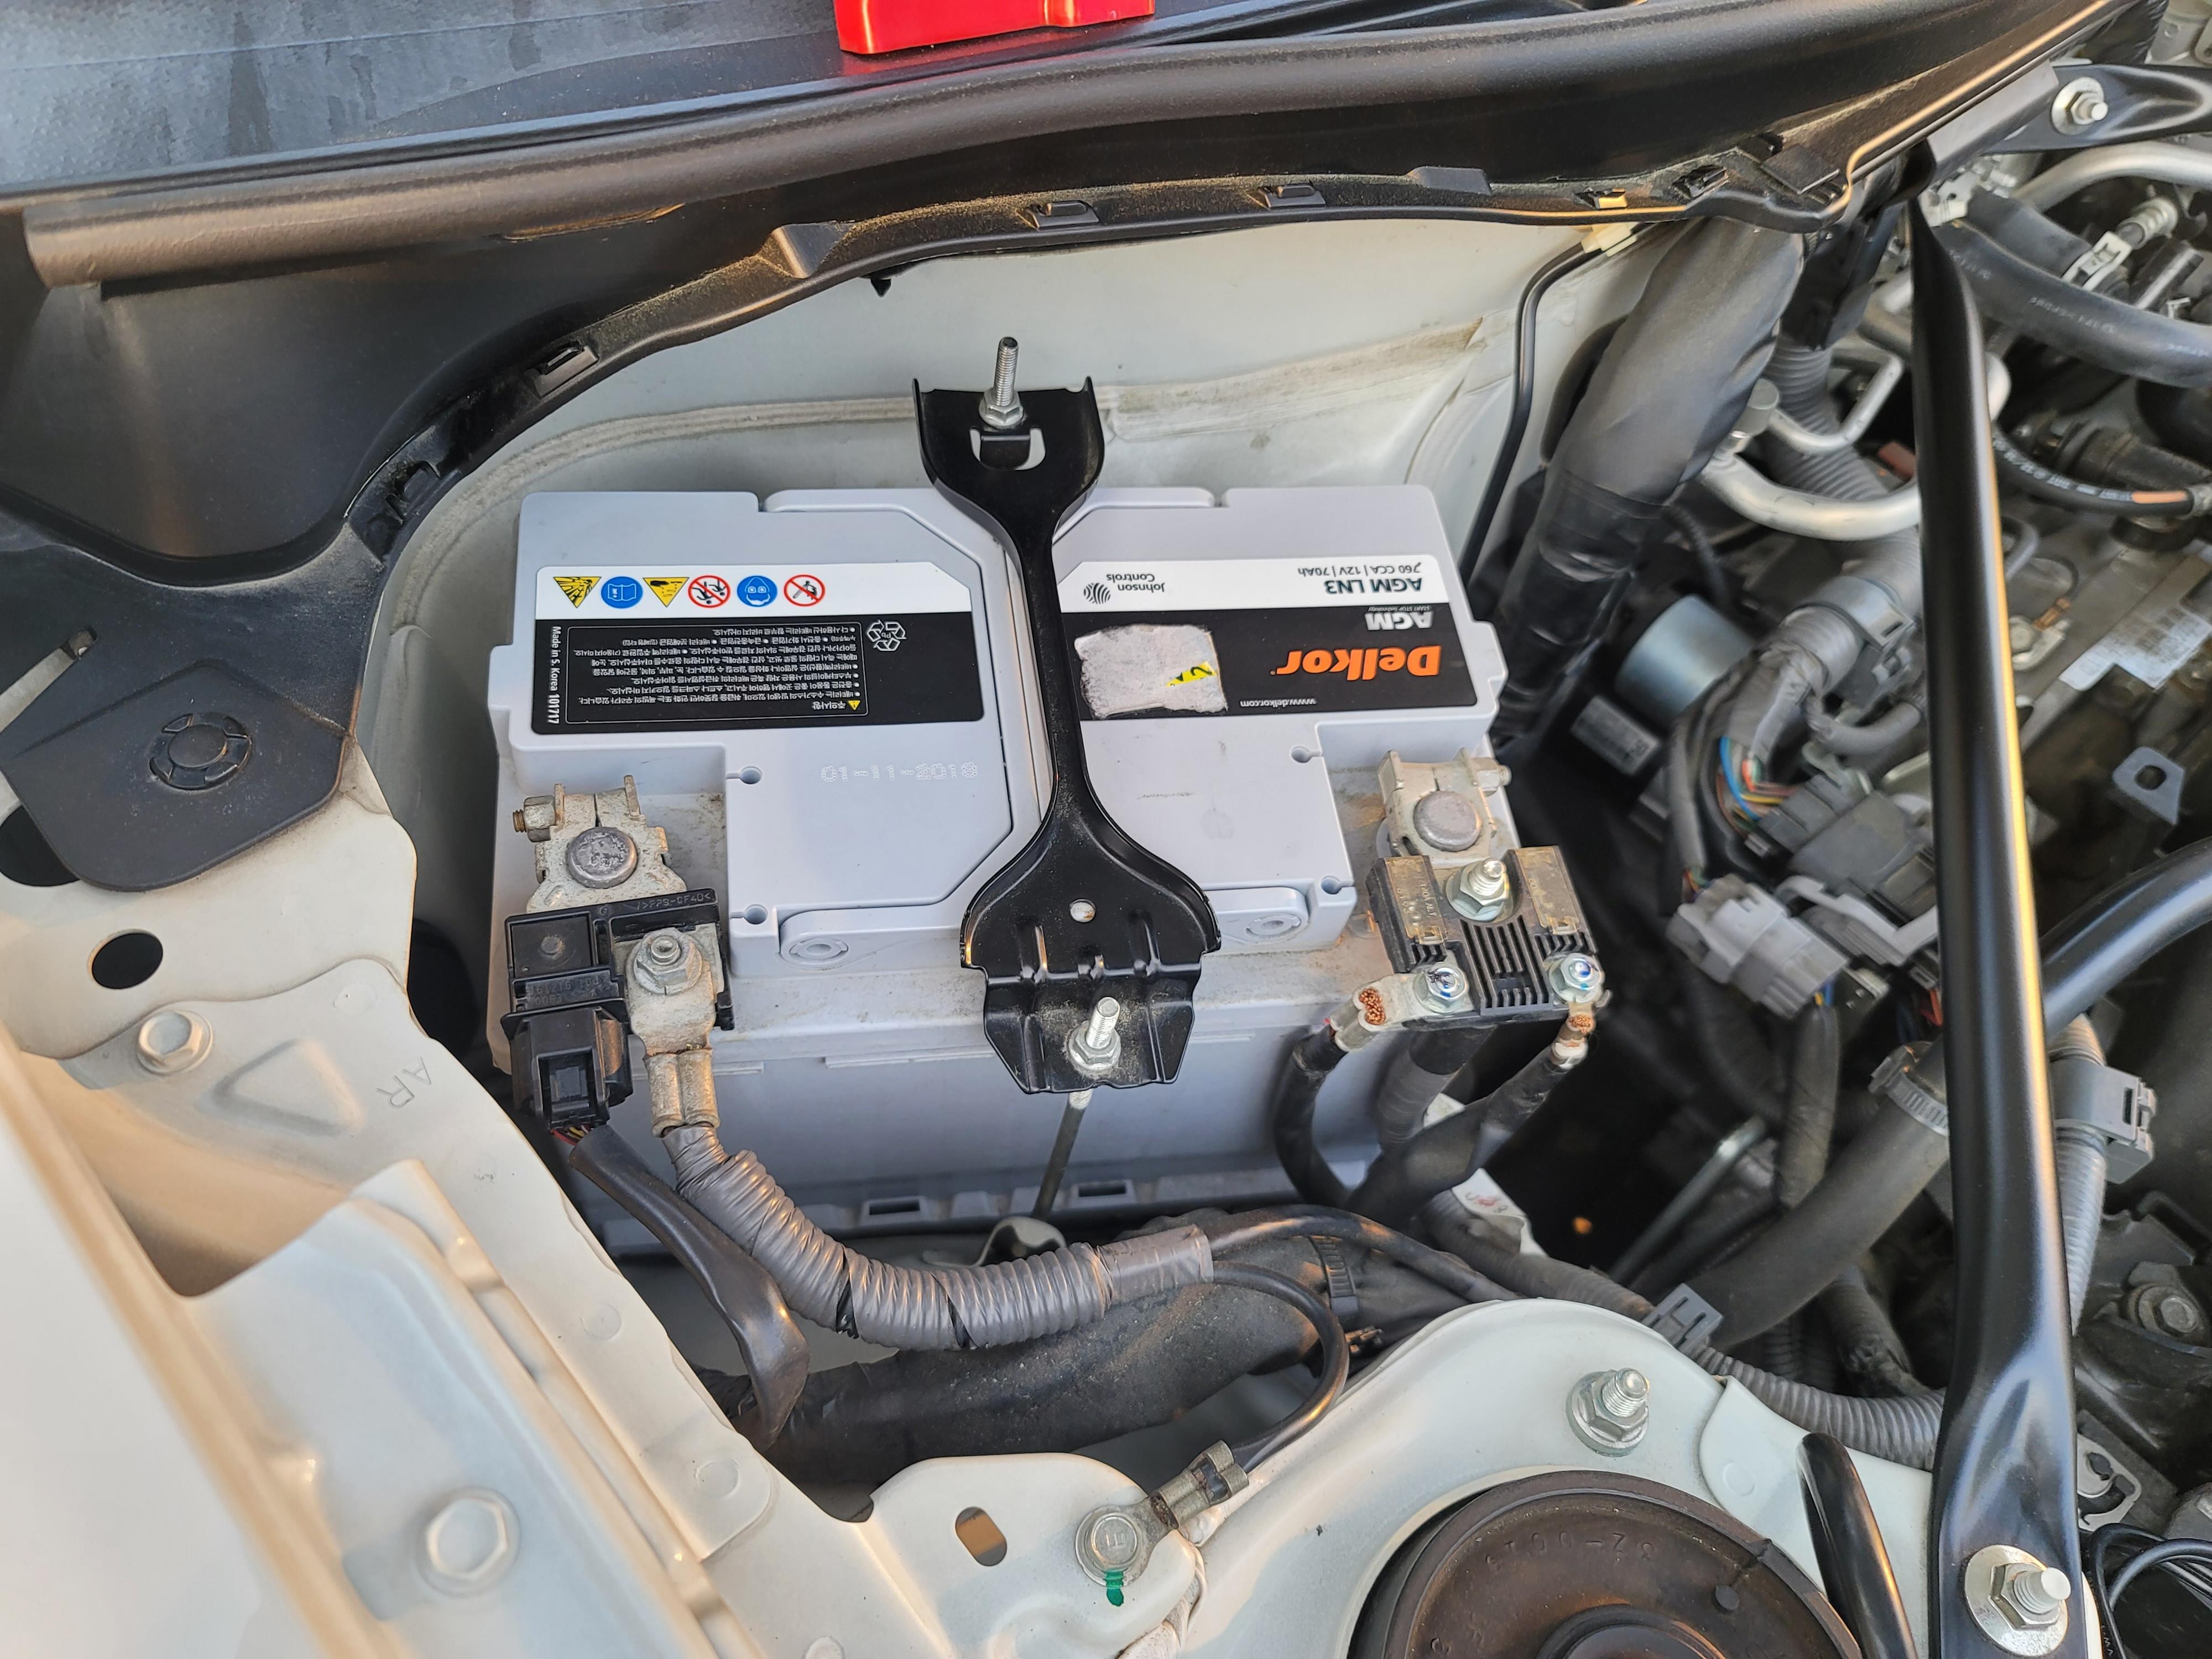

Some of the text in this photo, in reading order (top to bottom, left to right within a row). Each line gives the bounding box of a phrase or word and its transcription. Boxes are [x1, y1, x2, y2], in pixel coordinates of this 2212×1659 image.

[1107, 574, 1155, 583] Controls
[1298, 563, 1421, 577] 760 CCA 12V 70Ah
[1118, 583, 1165, 593] Johnson
[1324, 578, 1423, 594] AGM LN3
[1365, 611, 1433, 630] AGM
[551, 626, 561, 648] Made
[1276, 645, 1442, 681] Delkor
[550, 667, 560, 691] Korea
[547, 693, 560, 724] 101717
[1240, 697, 1317, 708] www.delkor.com
